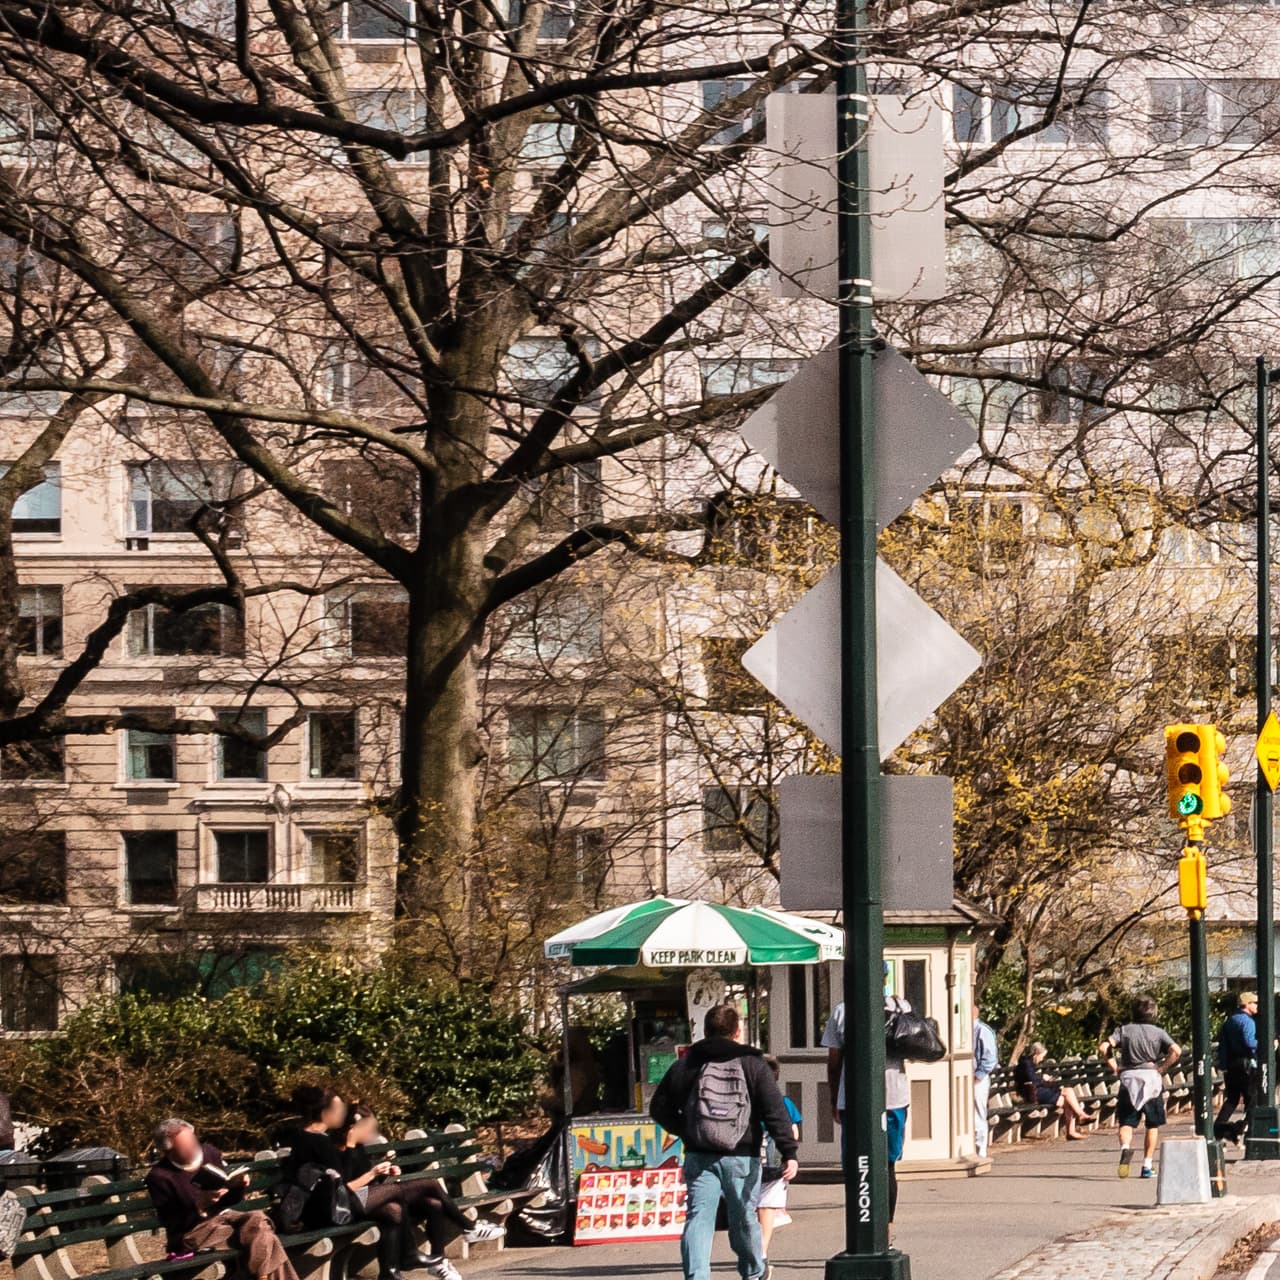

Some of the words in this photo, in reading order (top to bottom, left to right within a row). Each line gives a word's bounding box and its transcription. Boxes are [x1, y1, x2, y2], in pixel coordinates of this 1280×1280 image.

[650, 950, 676, 965] KEEP
[677, 950, 705, 964] PARK
[706, 950, 737, 964] CLEAN
[858, 1155, 871, 1223] E7202
